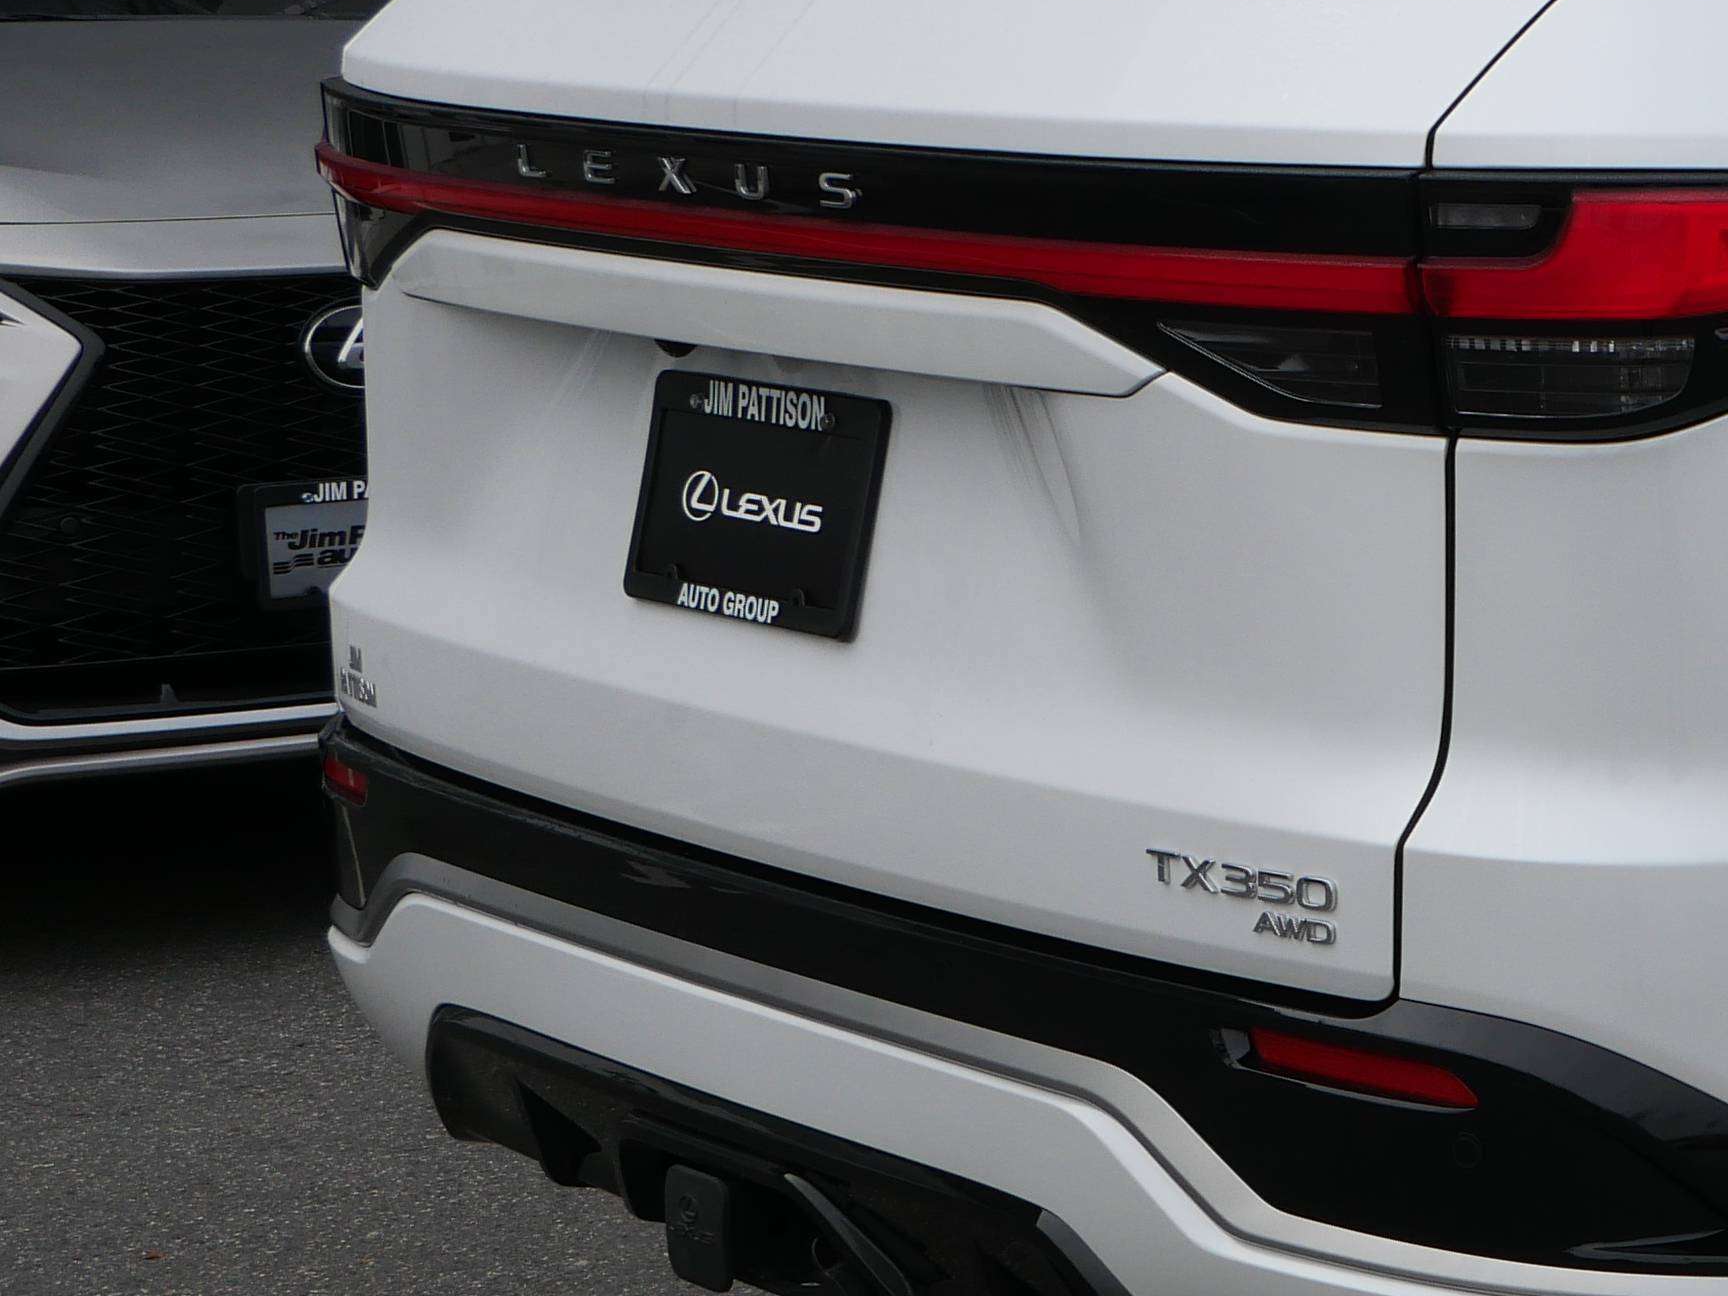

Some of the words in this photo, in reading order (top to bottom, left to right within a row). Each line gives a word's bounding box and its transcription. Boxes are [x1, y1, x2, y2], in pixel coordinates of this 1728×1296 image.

[516, 144, 864, 209] LEXUS
[704, 380, 733, 418] JIM
[737, 384, 826, 432] PATTISON
[313, 482, 347, 503] JIM
[720, 488, 823, 533] LEXUS
[677, 583, 720, 613] AUTO
[723, 590, 781, 625] GROUP
[1146, 848, 1338, 913] TX350
[1251, 910, 1337, 946] AWD
